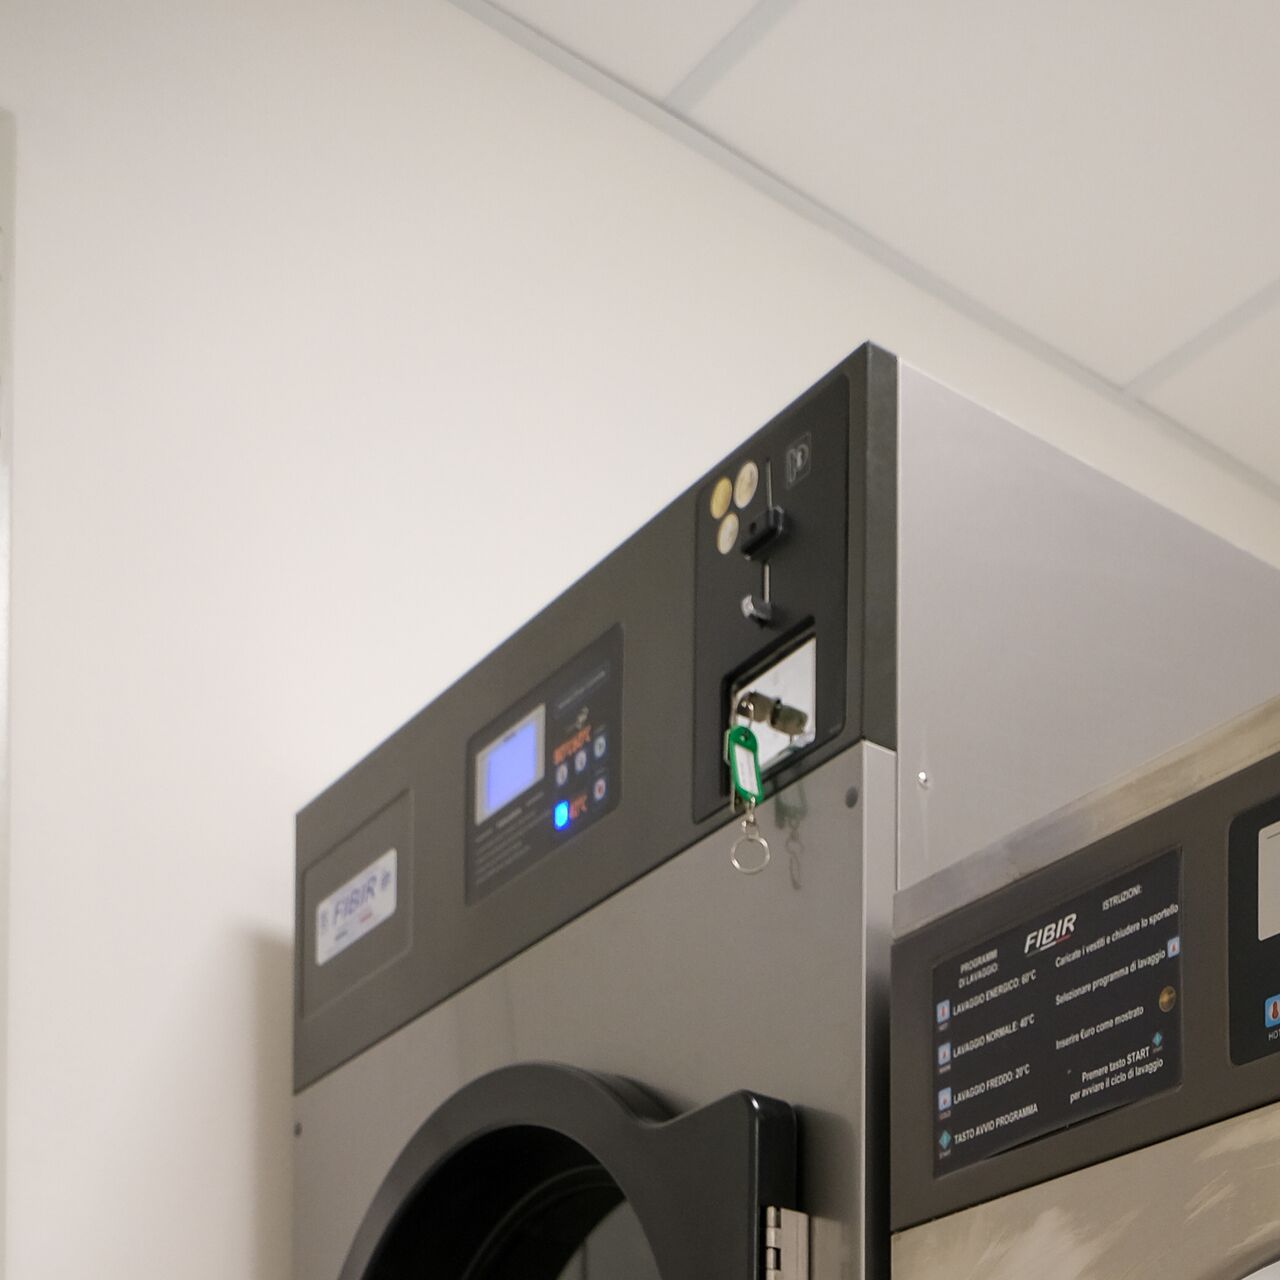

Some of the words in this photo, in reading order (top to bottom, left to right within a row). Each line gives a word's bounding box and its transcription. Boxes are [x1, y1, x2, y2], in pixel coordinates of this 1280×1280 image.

[1024, 913, 1077, 954] FIBIR
[1111, 921, 1141, 942] chiudere
[1141, 917, 1148, 929] lo
[1092, 965, 1129, 992] programma
[1130, 961, 1137, 973] di
[1137, 949, 1166, 969] lavaggio
[953, 993, 985, 1016] LAVAGGIO
[1096, 1019, 1114, 1033] come
[1115, 1006, 1144, 1025] mostrato
[953, 1035, 985, 1058] LAVAGGIO
[1082, 1065, 1109, 1083] Premere
[1109, 1058, 1126, 1072] tasto
[1127, 1046, 1150, 1065] START
[953, 1083, 985, 1104] LAVAGGIO
[1070, 1091, 1082, 1104] per
[1082, 1082, 1105, 1098] avviare
[1111, 1071, 1127, 1086] ciclo
[1127, 1067, 1134, 1079] di
[1135, 1058, 1164, 1077] lavaggio
[954, 1128, 974, 1145] TASTO
[996, 1103, 1039, 1128] PROGRAMMA
